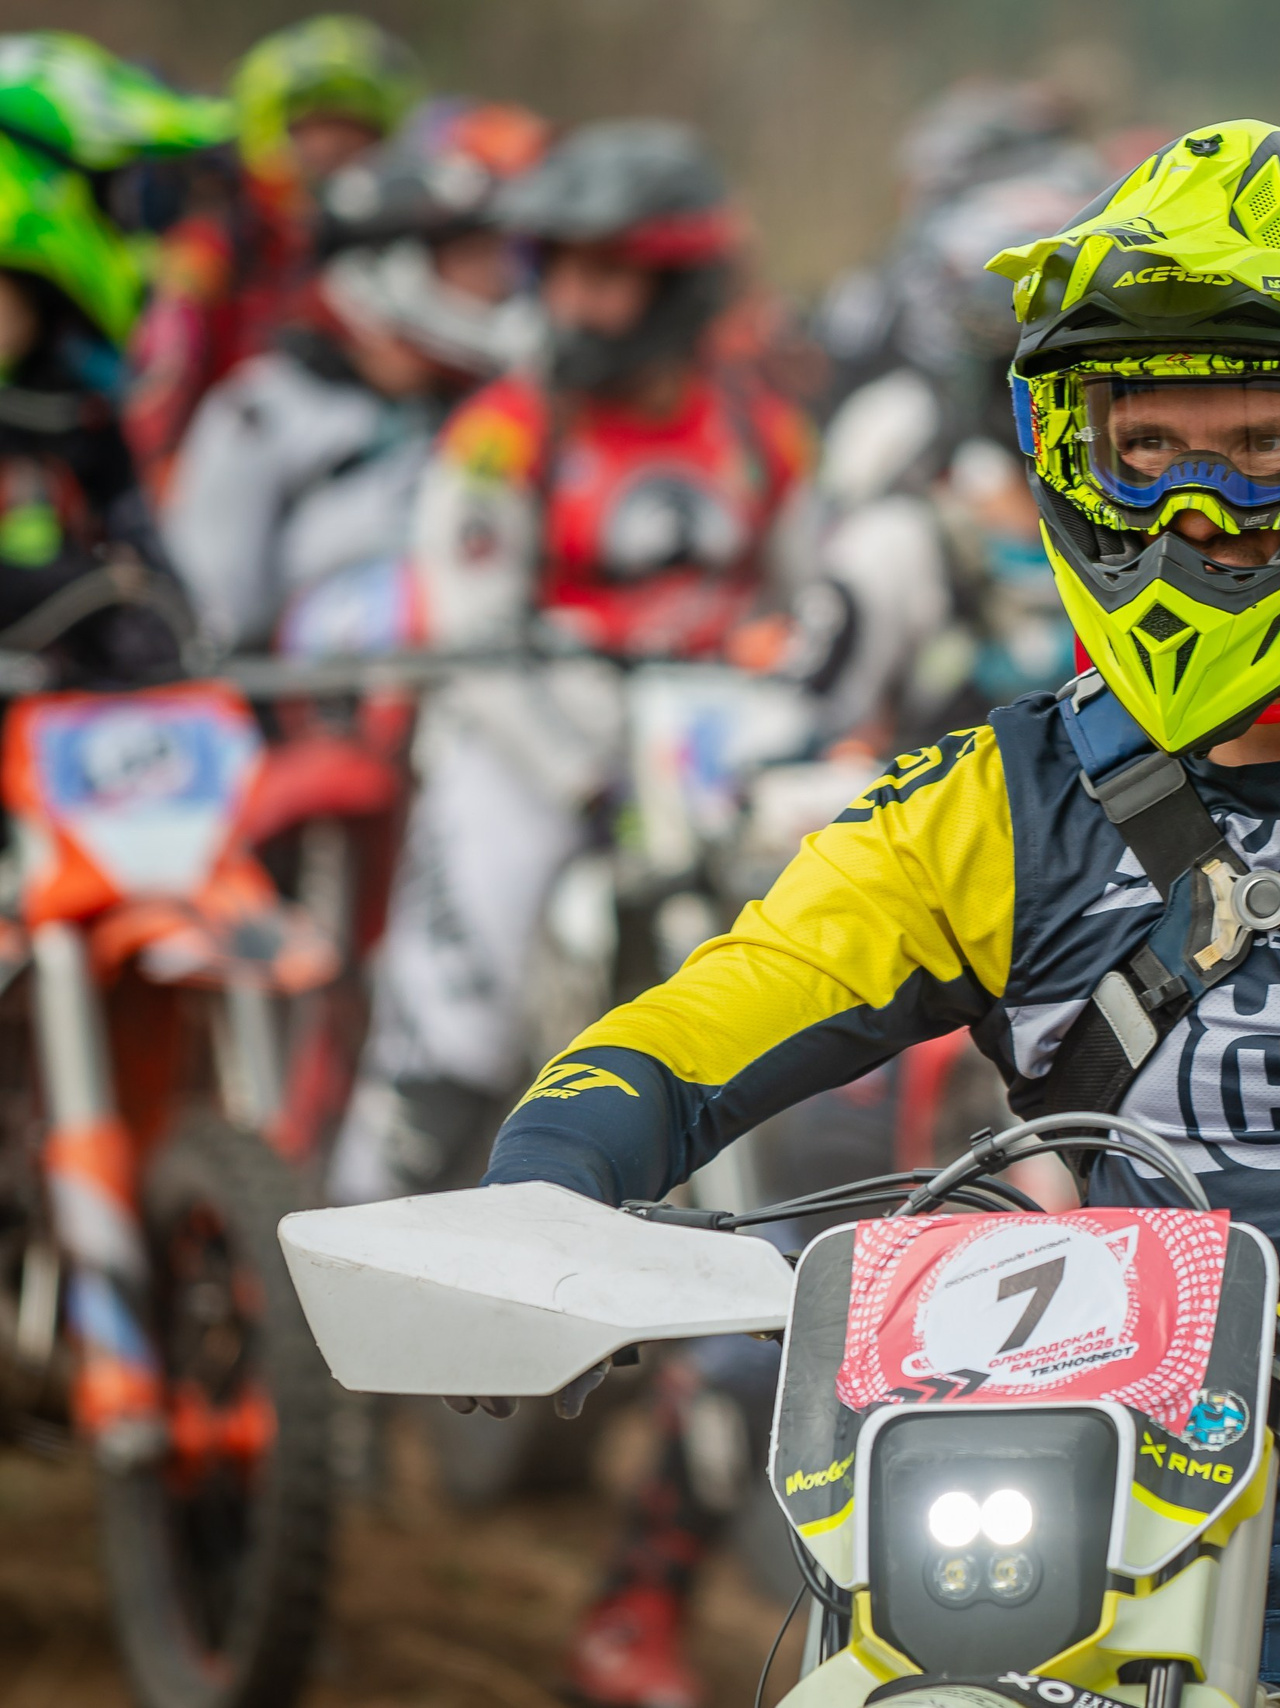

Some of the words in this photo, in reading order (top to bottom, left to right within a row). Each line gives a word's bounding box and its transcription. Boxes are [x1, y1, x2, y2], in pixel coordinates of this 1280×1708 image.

[996, 1256, 1066, 1355] 7
[988, 1326, 1106, 1368] СЛОБОДСКАЯ
[1010, 1350, 1069, 1373] БАЛКА
[1072, 1337, 1114, 1356] 2025
[1030, 1346, 1134, 1377] ТЕХНОФЕСТ
[1168, 1452, 1234, 1485] RMG
